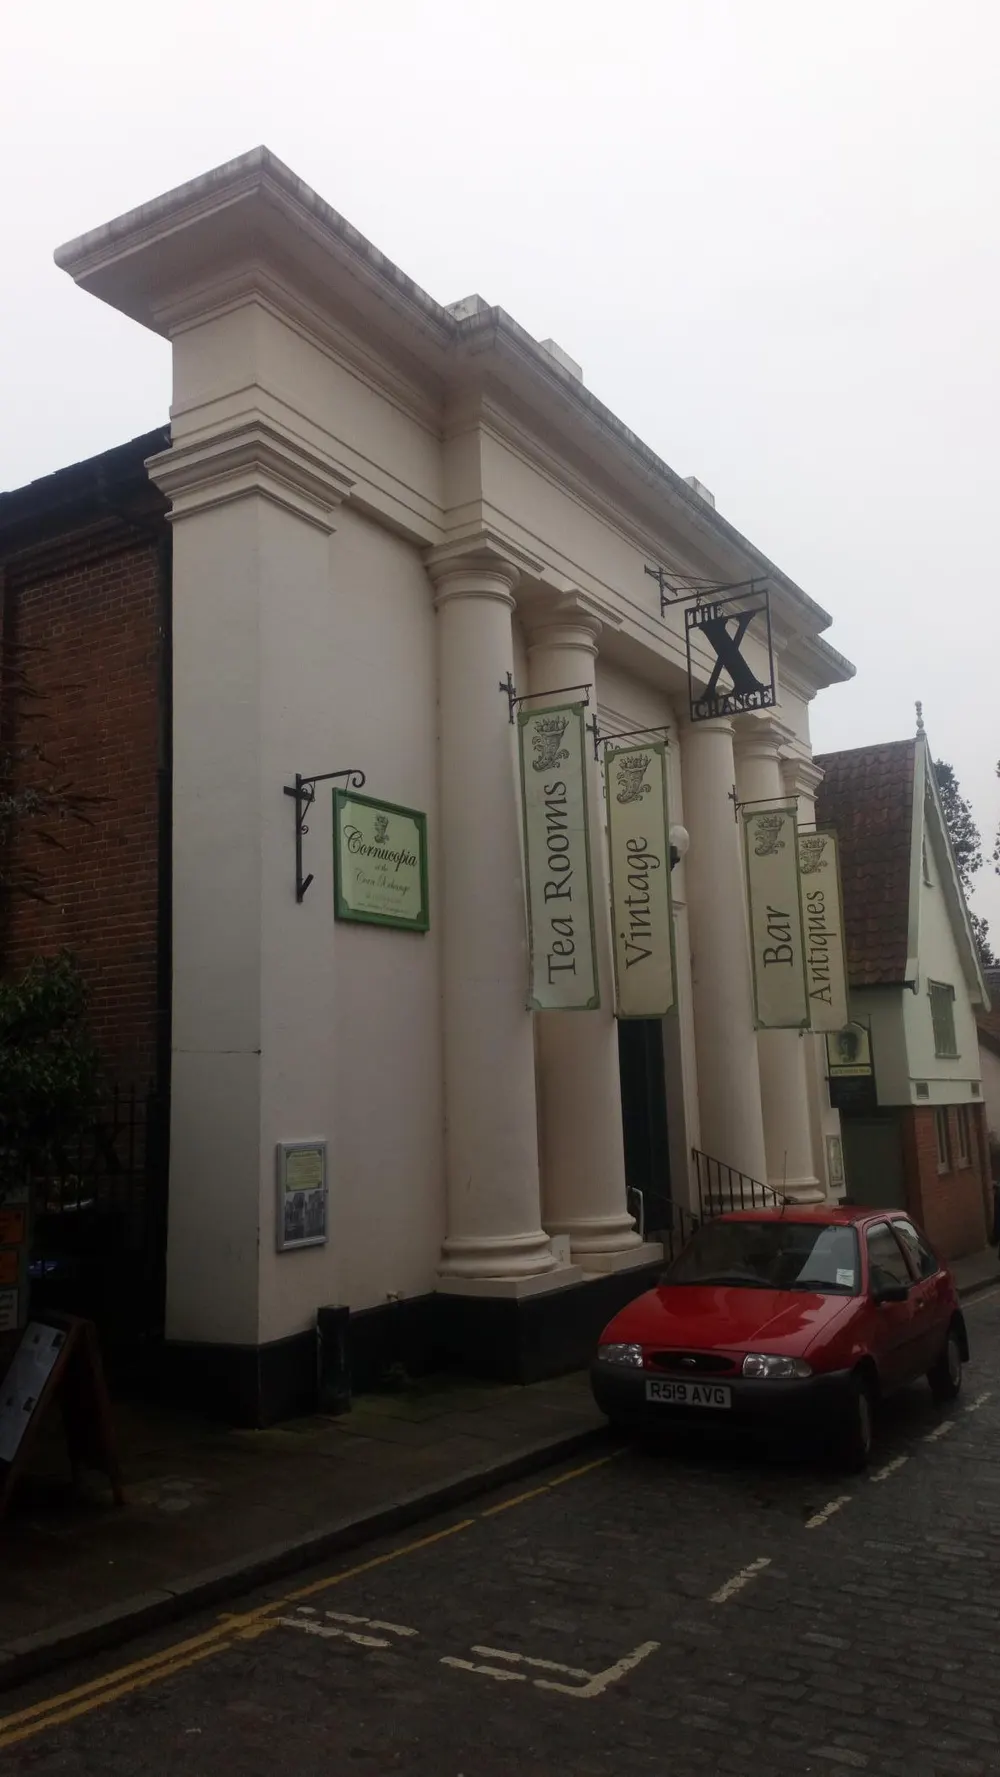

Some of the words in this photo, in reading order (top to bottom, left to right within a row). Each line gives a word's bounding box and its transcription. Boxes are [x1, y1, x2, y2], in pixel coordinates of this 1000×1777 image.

[687, 605, 724, 626] THE
[698, 611, 763, 699] X
[695, 687, 773, 718] CHANGE
[344, 825, 418, 872] Cornucopia
[543, 780, 574, 904] Rooms
[620, 835, 661, 969] Vintage
[547, 914, 577, 985] Tea
[763, 905, 793, 968] Bar
[806, 889, 837, 1006] Antiques
[650, 1382, 687, 1401] R519
[692, 1386, 725, 1405] AVG
